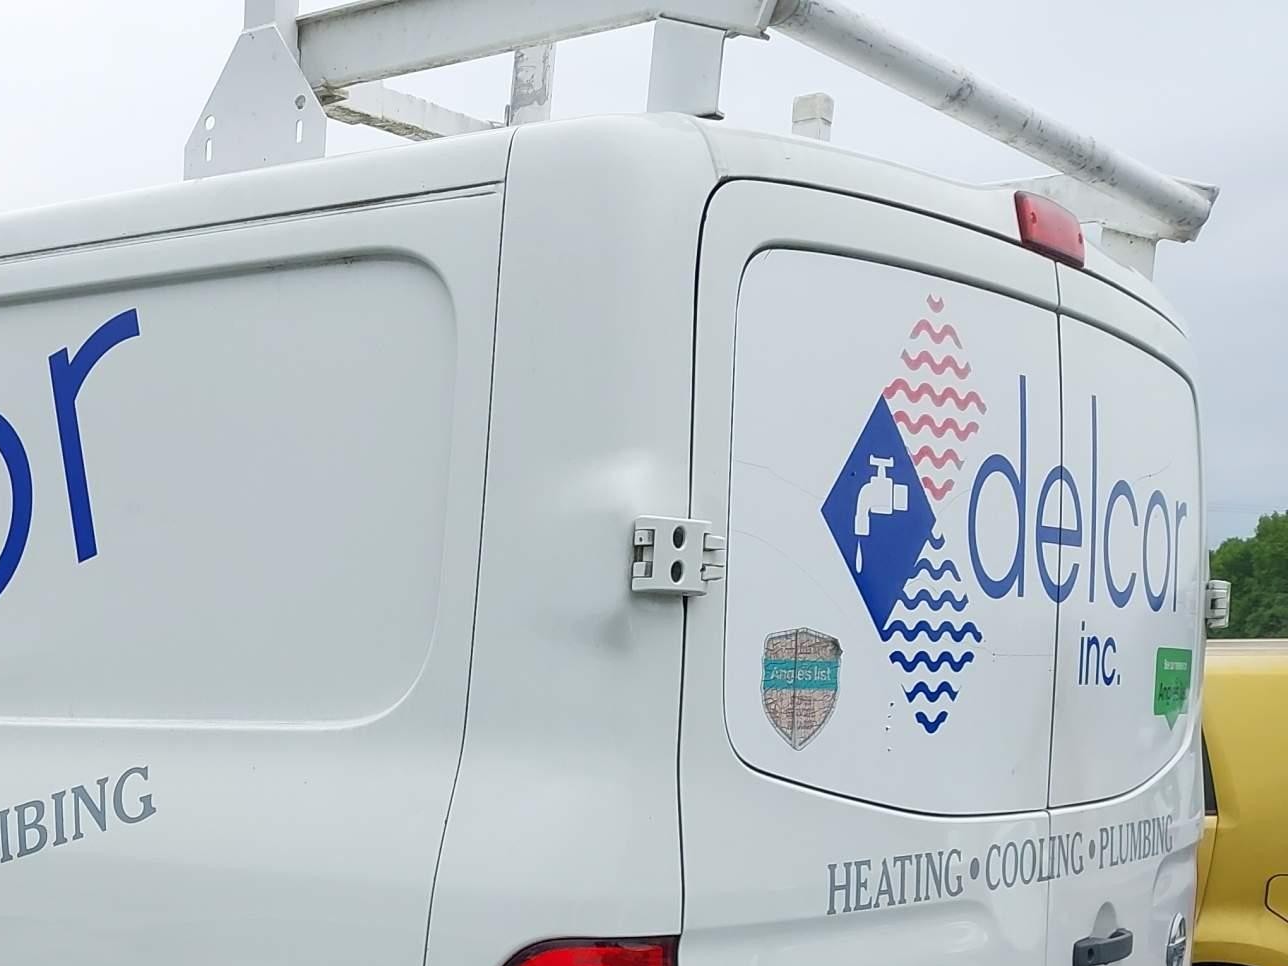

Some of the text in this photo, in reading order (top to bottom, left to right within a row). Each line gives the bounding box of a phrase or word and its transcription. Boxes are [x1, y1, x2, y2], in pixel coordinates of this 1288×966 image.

[968, 375, 1186, 612] delcor
[1078, 621, 1120, 685] inc.
[827, 814, 1173, 915] HEATING COOLING PLUMBING
